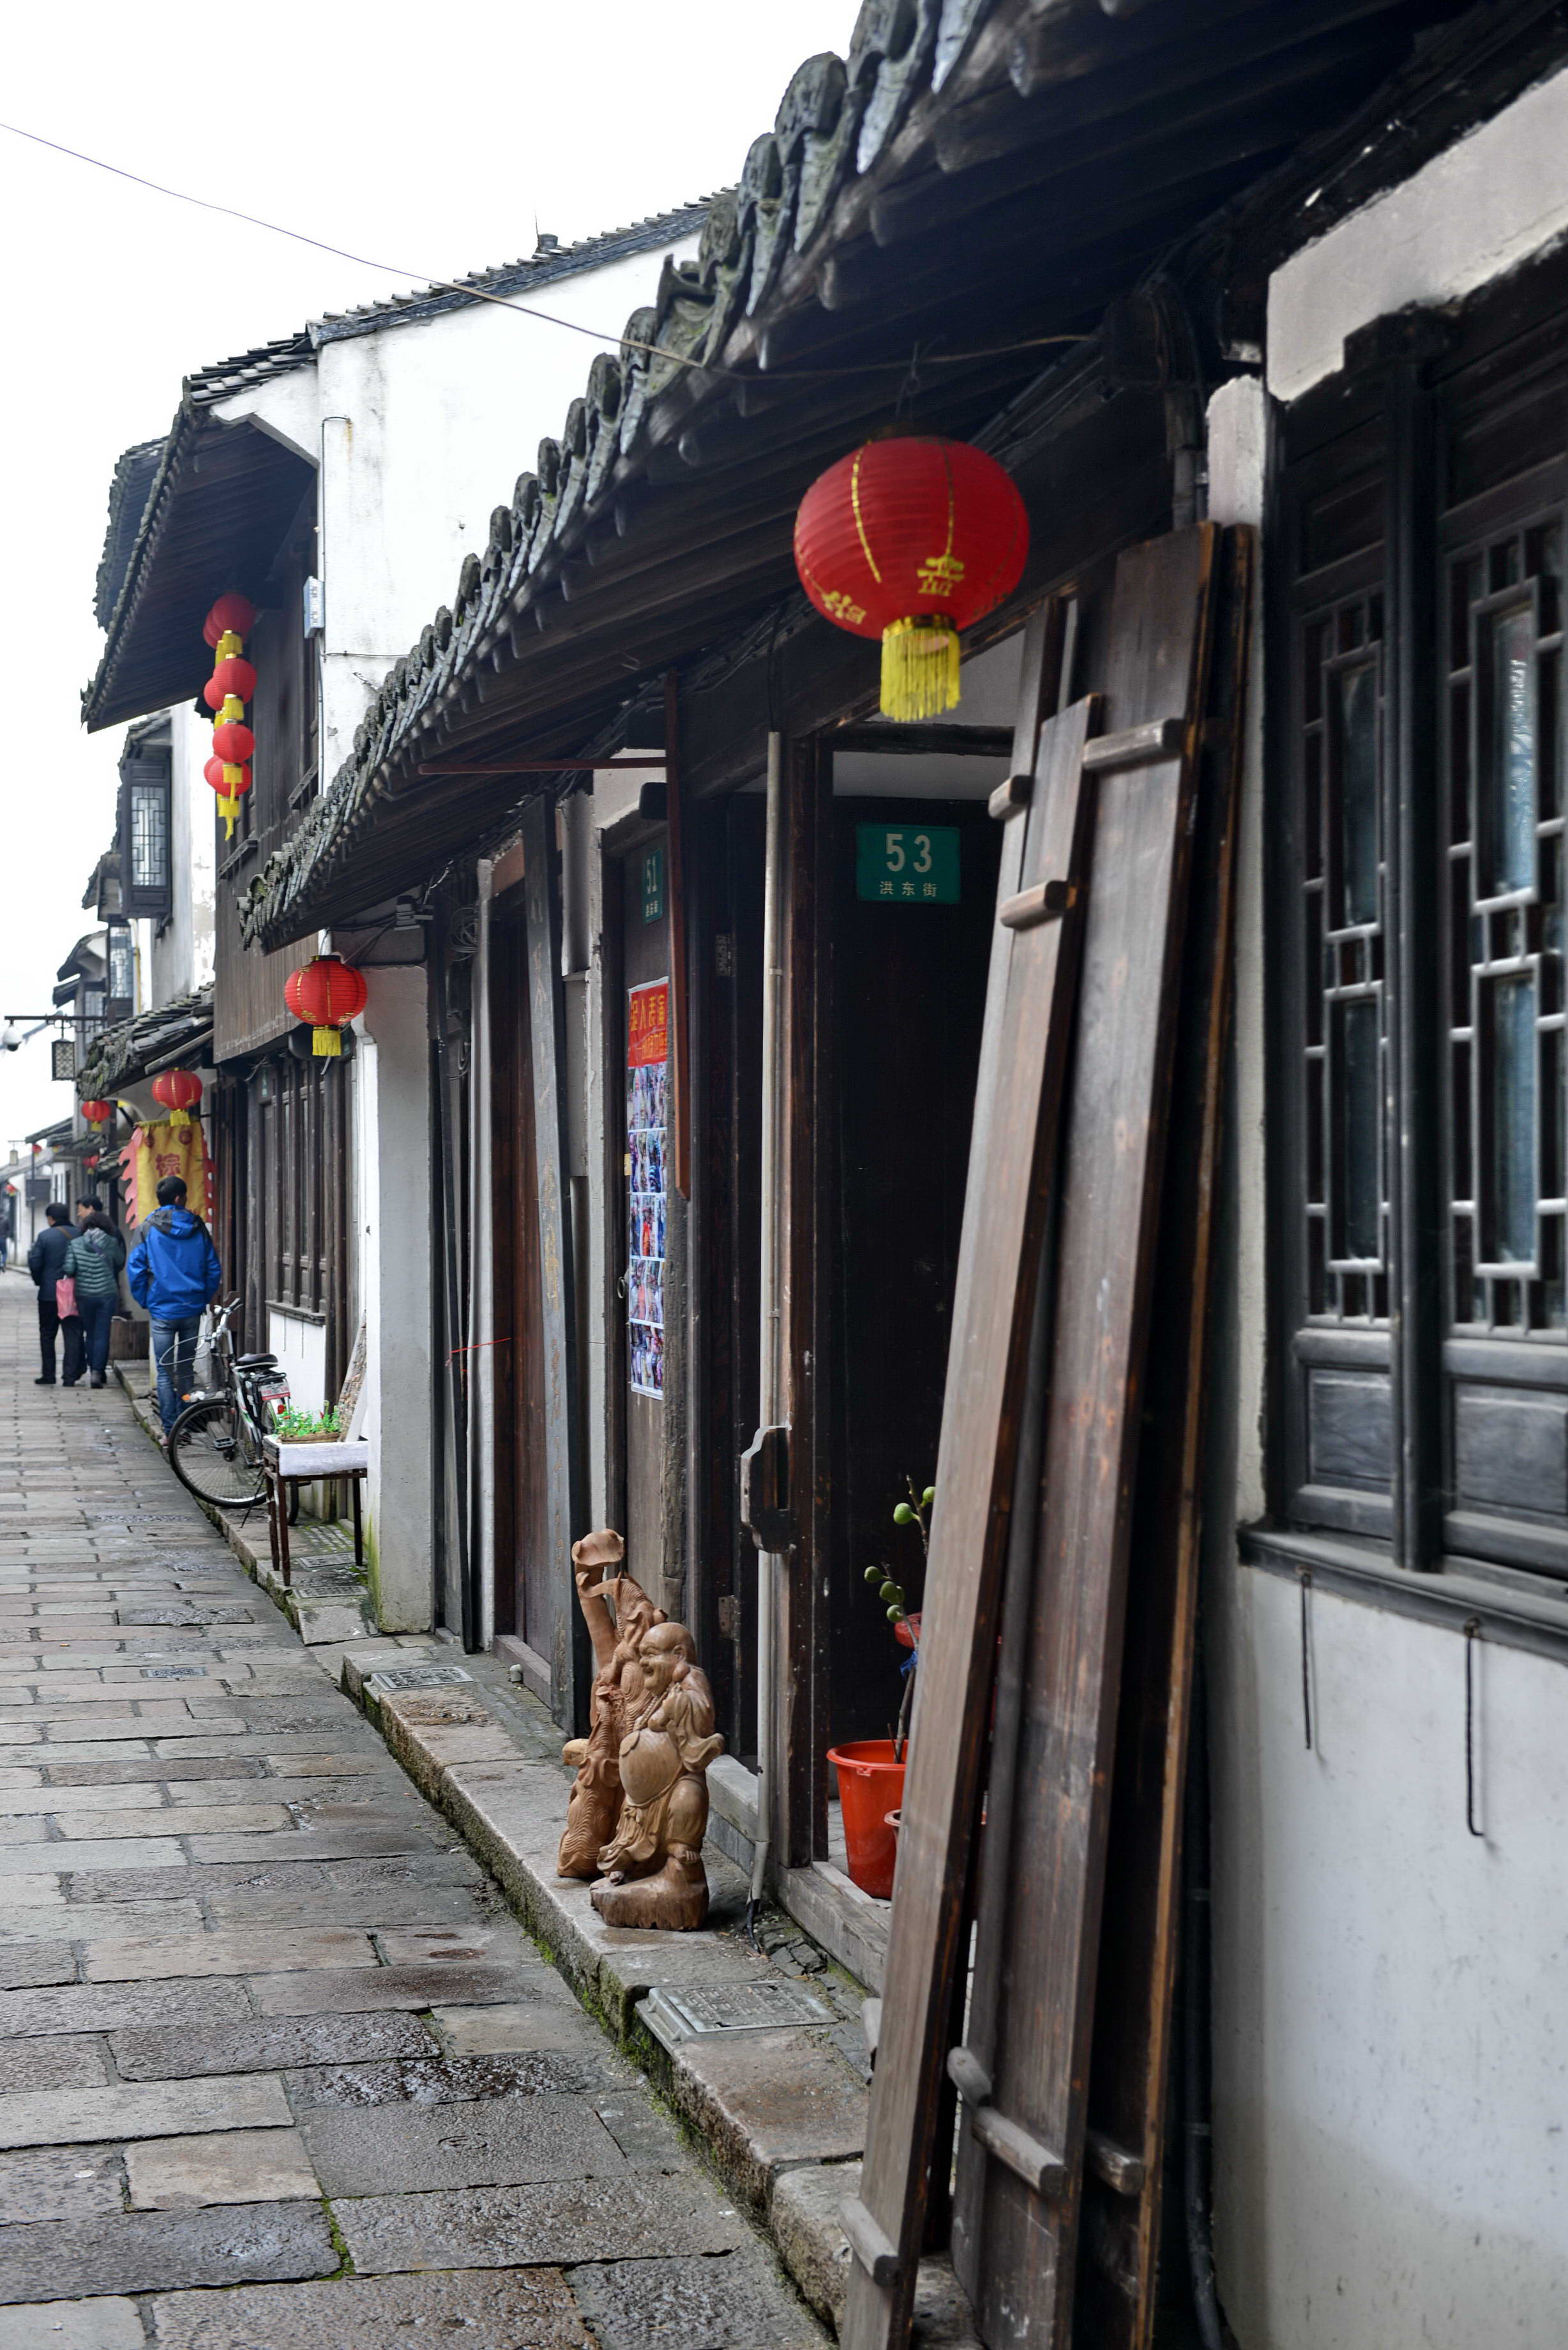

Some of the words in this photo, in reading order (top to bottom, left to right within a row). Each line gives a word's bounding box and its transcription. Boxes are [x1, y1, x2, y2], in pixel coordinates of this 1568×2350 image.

[886, 833, 933, 873] 53
[646, 856, 658, 894] 51
[879, 880, 938, 897] 洪东街
